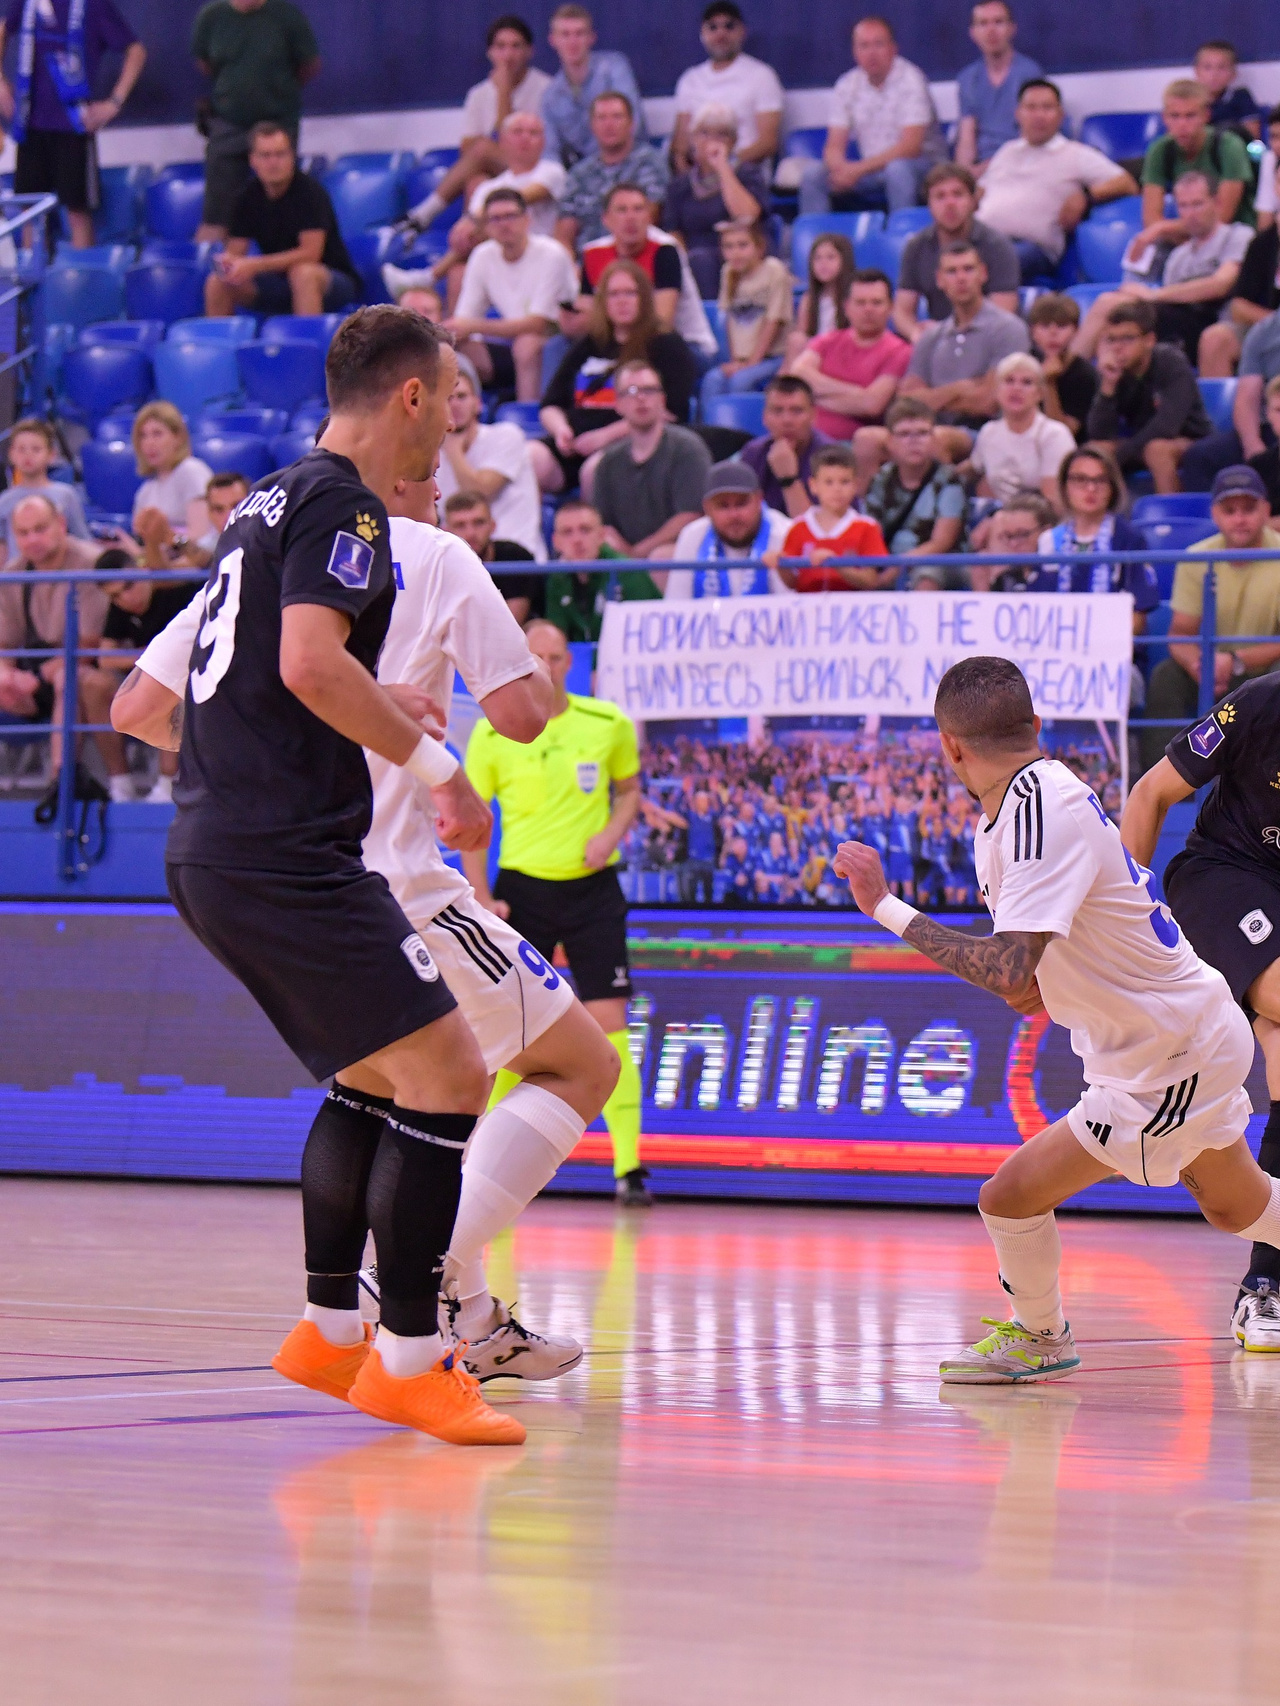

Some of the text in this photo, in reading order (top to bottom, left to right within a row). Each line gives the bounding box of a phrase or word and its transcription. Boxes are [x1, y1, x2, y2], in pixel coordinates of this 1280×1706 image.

[623, 601, 1093, 655] НОРИЛЬСКИЙ НИКЕЛЬ НЕ ОДИН!
[774, 656, 912, 705] НОРИЛЬСК,
[517, 939, 561, 991] 9
[628, 996, 974, 1117] inline
